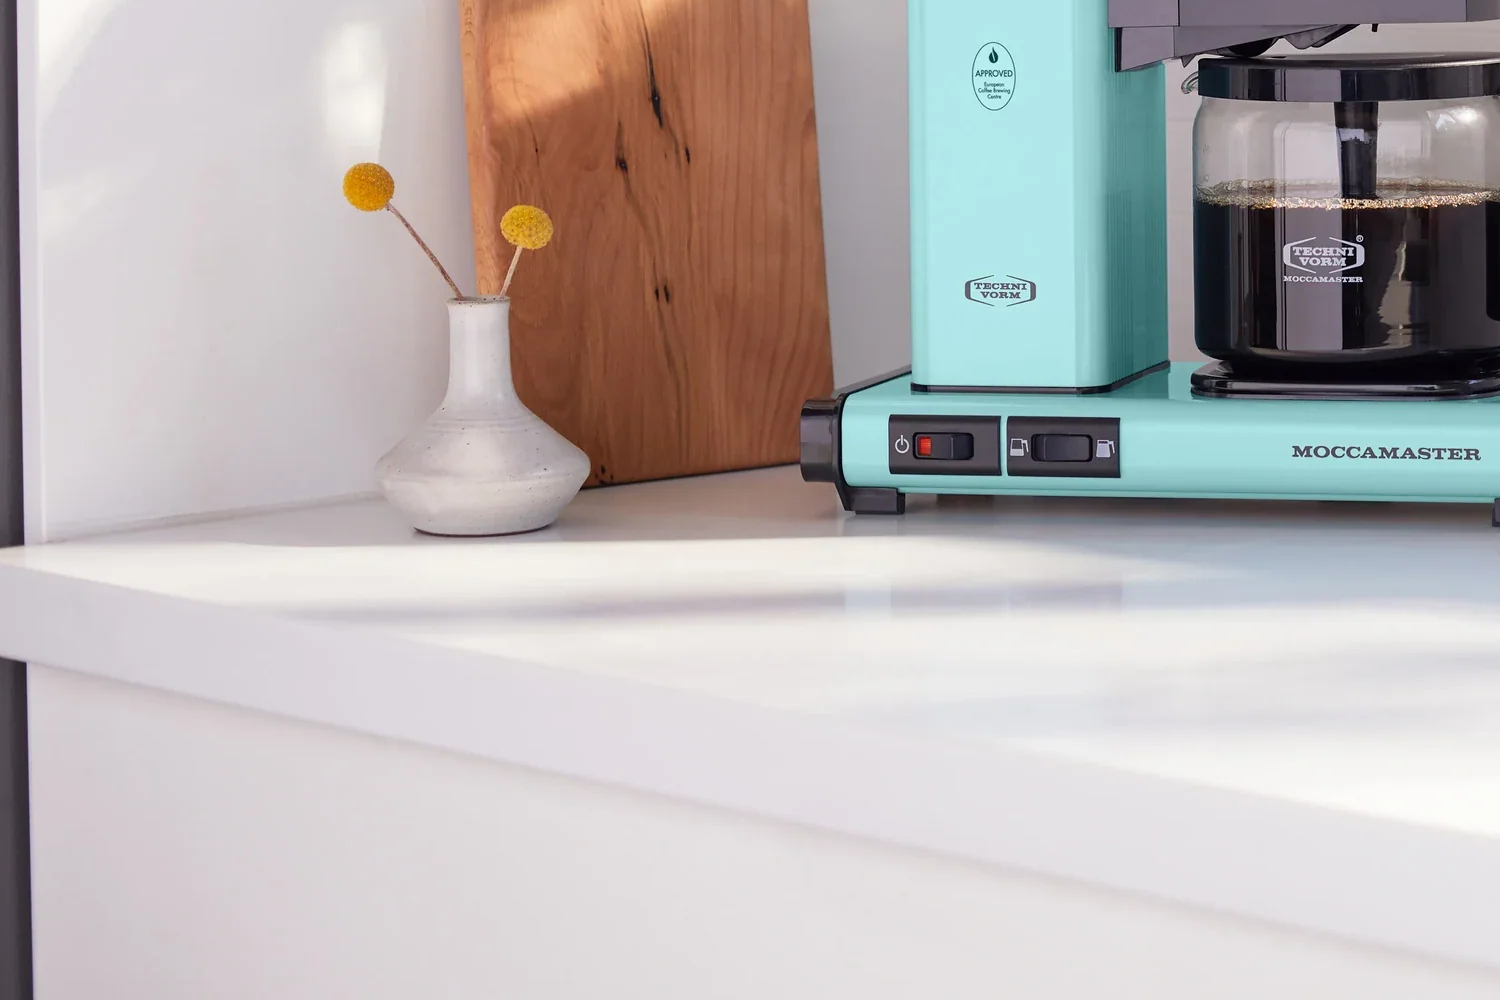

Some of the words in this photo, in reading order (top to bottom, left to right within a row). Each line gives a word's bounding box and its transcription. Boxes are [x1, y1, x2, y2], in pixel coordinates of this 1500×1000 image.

[1293, 247, 1354, 256] TECHNI
[1299, 257, 1346, 266] VORM
[974, 282, 1027, 290] TECHNI
[980, 291, 1021, 299] VORM
[1292, 446, 1481, 461] MOCCAMASTER
